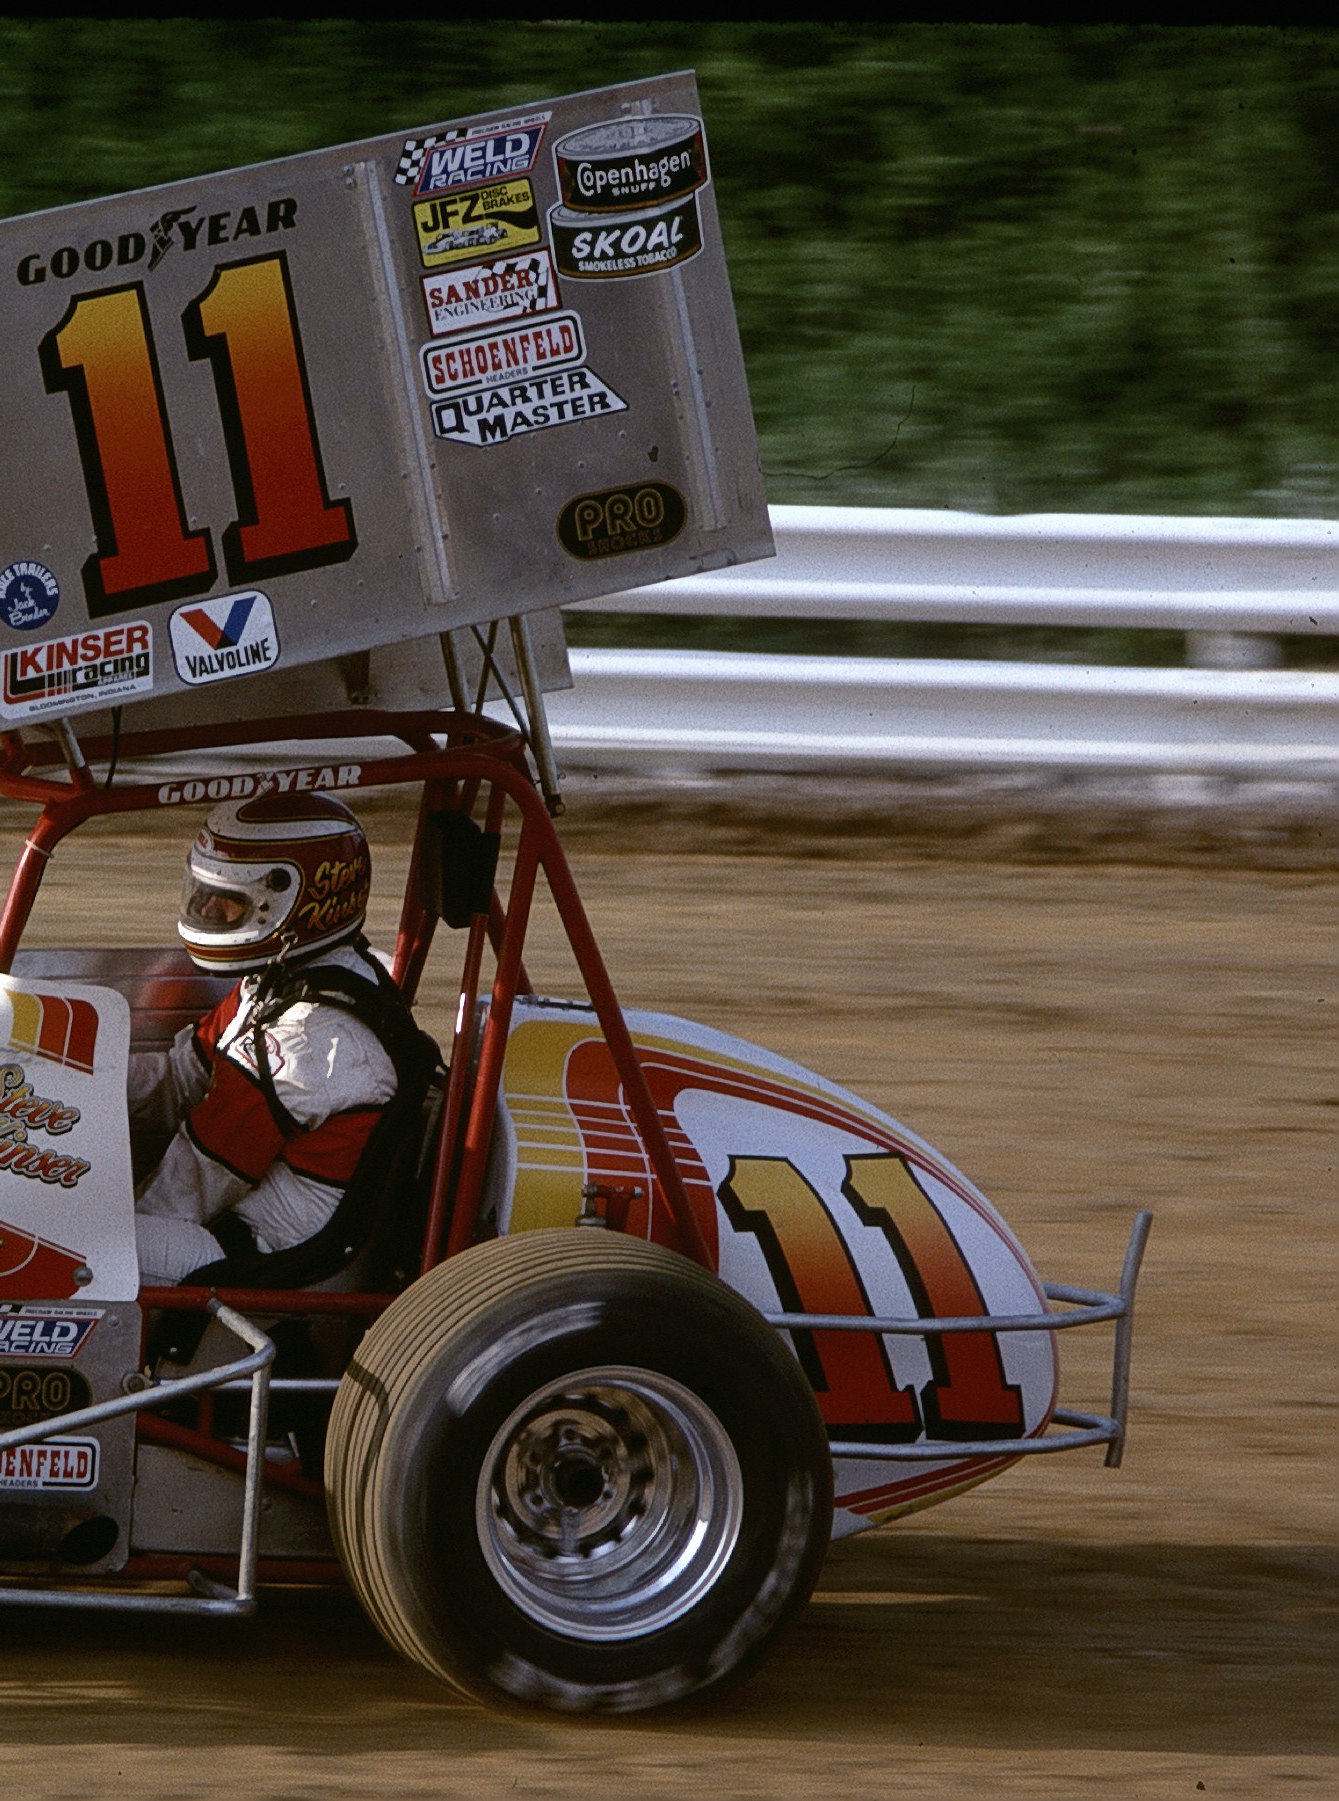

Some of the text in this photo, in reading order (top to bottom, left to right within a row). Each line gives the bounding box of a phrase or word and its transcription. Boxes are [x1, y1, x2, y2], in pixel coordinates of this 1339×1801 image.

[430, 155, 533, 189] RACING
[431, 133, 530, 174] WELD
[481, 186, 508, 199] DISC
[577, 152, 691, 196] Copenhagen
[612, 182, 657, 196] SNUFF
[421, 192, 484, 232] JFZ
[483, 191, 530, 211] BRAKES
[572, 216, 683, 258] SKOAL
[579, 247, 678, 272] SMOKELESS TOBACCO
[429, 269, 534, 308] SANDER
[433, 286, 537, 321] ENGINEERING
[432, 324, 574, 386] SCHOENFELD
[486, 367, 529, 384] HEADERS
[435, 371, 592, 434] QUARTER
[479, 391, 611, 442] MASTER
[37, 250, 359, 619] 11
[575, 488, 665, 542] PRO
[20, 624, 149, 678] KINSER
[185, 637, 272, 679] VALVOLINE
[72, 652, 150, 691] racing
[99, 684, 136, 696] INDIANA
[717, 1153, 1026, 1444] 11
